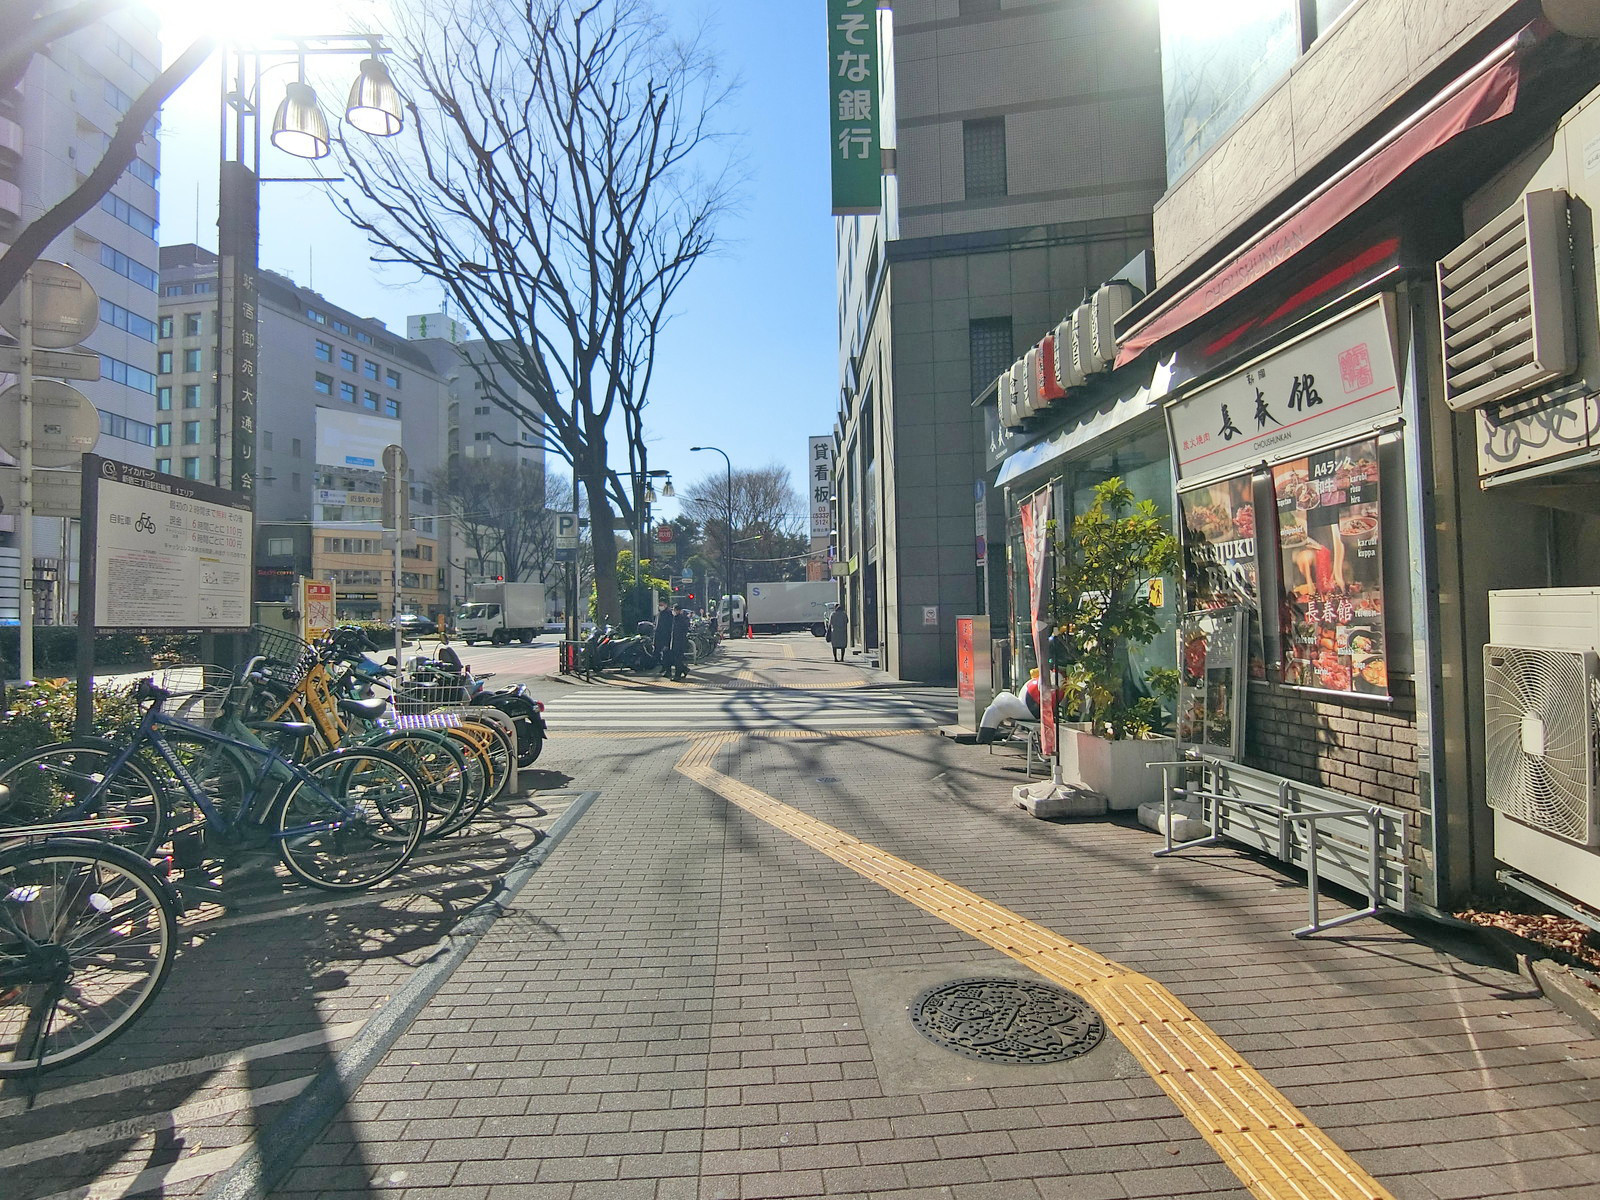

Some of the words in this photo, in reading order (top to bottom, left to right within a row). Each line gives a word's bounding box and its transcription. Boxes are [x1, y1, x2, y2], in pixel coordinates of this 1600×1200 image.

[837, 0, 872, 159] そな銀行
[1253, 431, 1292, 450] CHOUSHUNKAN
[122, 465, 156, 480] サイカパーク
[813, 443, 829, 503] 貸看板
[109, 513, 132, 526] 自転車
[560, 516, 574, 536] P
[1305, 598, 1353, 623] 長春館
[158, 739, 202, 795] BRIDGESTONE
